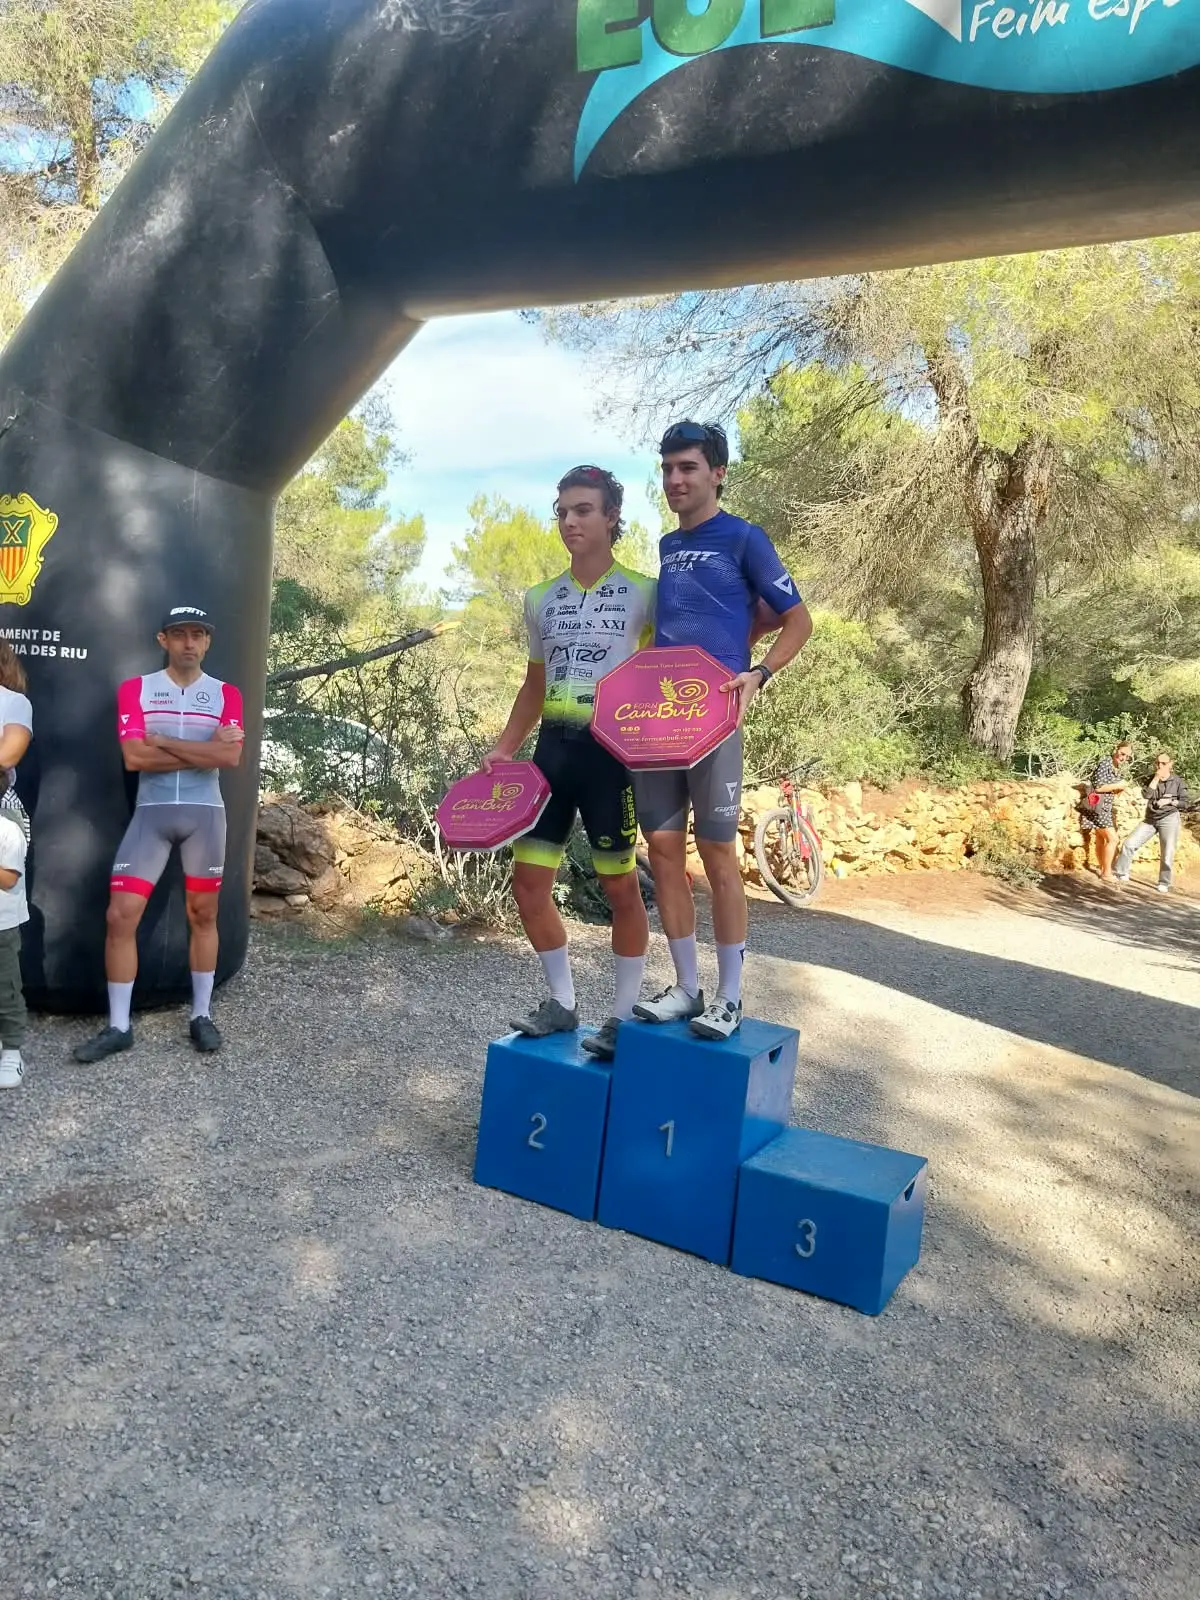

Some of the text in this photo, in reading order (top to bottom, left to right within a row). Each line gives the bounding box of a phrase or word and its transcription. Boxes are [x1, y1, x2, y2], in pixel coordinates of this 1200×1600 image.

[1088, 0, 1181, 35] esp
[667, 562, 694, 573] IBIZA
[42, 630, 61, 641] DE
[558, 620, 626, 630] ibiza S. XXI
[31, 644, 57, 657] DES
[60, 646, 88, 659] RIU
[626, 785, 635, 826] SERRA
[527, 1112, 547, 1149] 2
[658, 1119, 675, 1157] 1
[795, 1218, 816, 1258] 3
